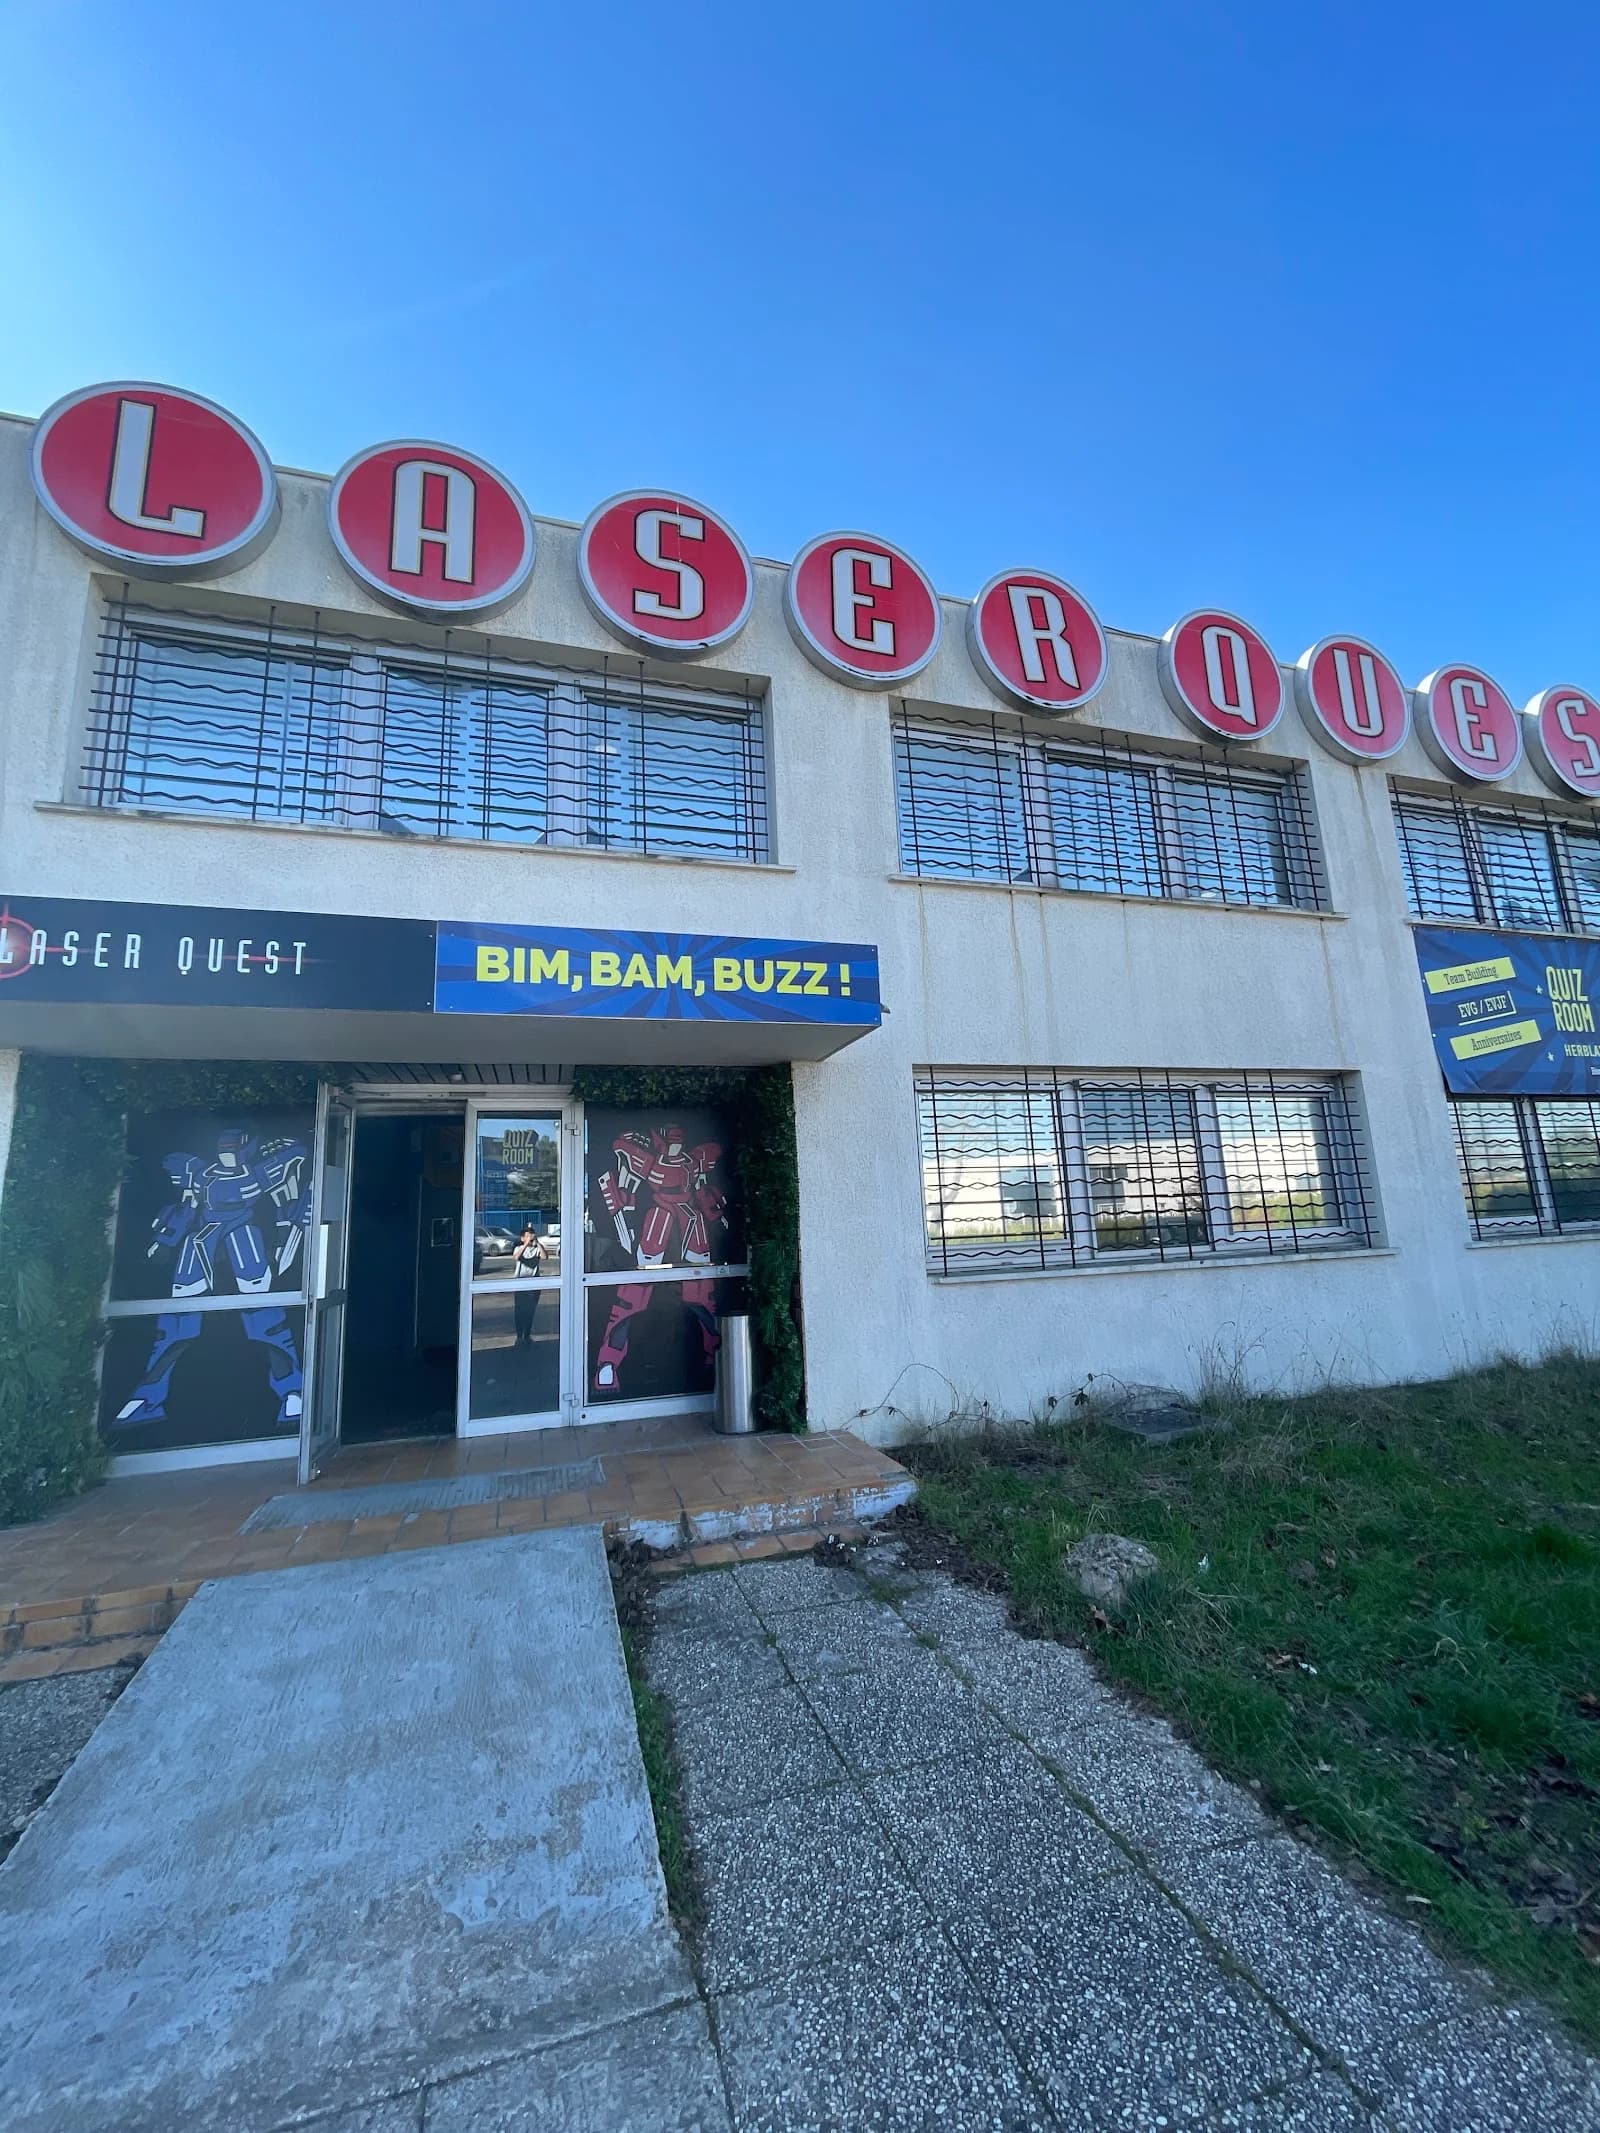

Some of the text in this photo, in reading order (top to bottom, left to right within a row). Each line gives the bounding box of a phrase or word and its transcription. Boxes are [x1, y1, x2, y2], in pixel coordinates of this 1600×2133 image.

[108, 398, 1080, 692] LASER
[0, 928, 307, 975] LASER QUEST
[476, 945, 583, 993] BIM,
[590, 951, 705, 997] BAM,
[713, 957, 829, 996] BUZZ
[1443, 967, 1498, 985] Team Building
[1546, 966, 1589, 1002] QUIZ
[1458, 1002, 1479, 1018] EVG
[1484, 995, 1507, 1012] EVJF
[1552, 1002, 1595, 1033] ROOM
[1471, 1030, 1522, 1051] Anniversaires
[503, 1129, 534, 1149] QUIZ
[502, 1148, 534, 1165] ROOM
